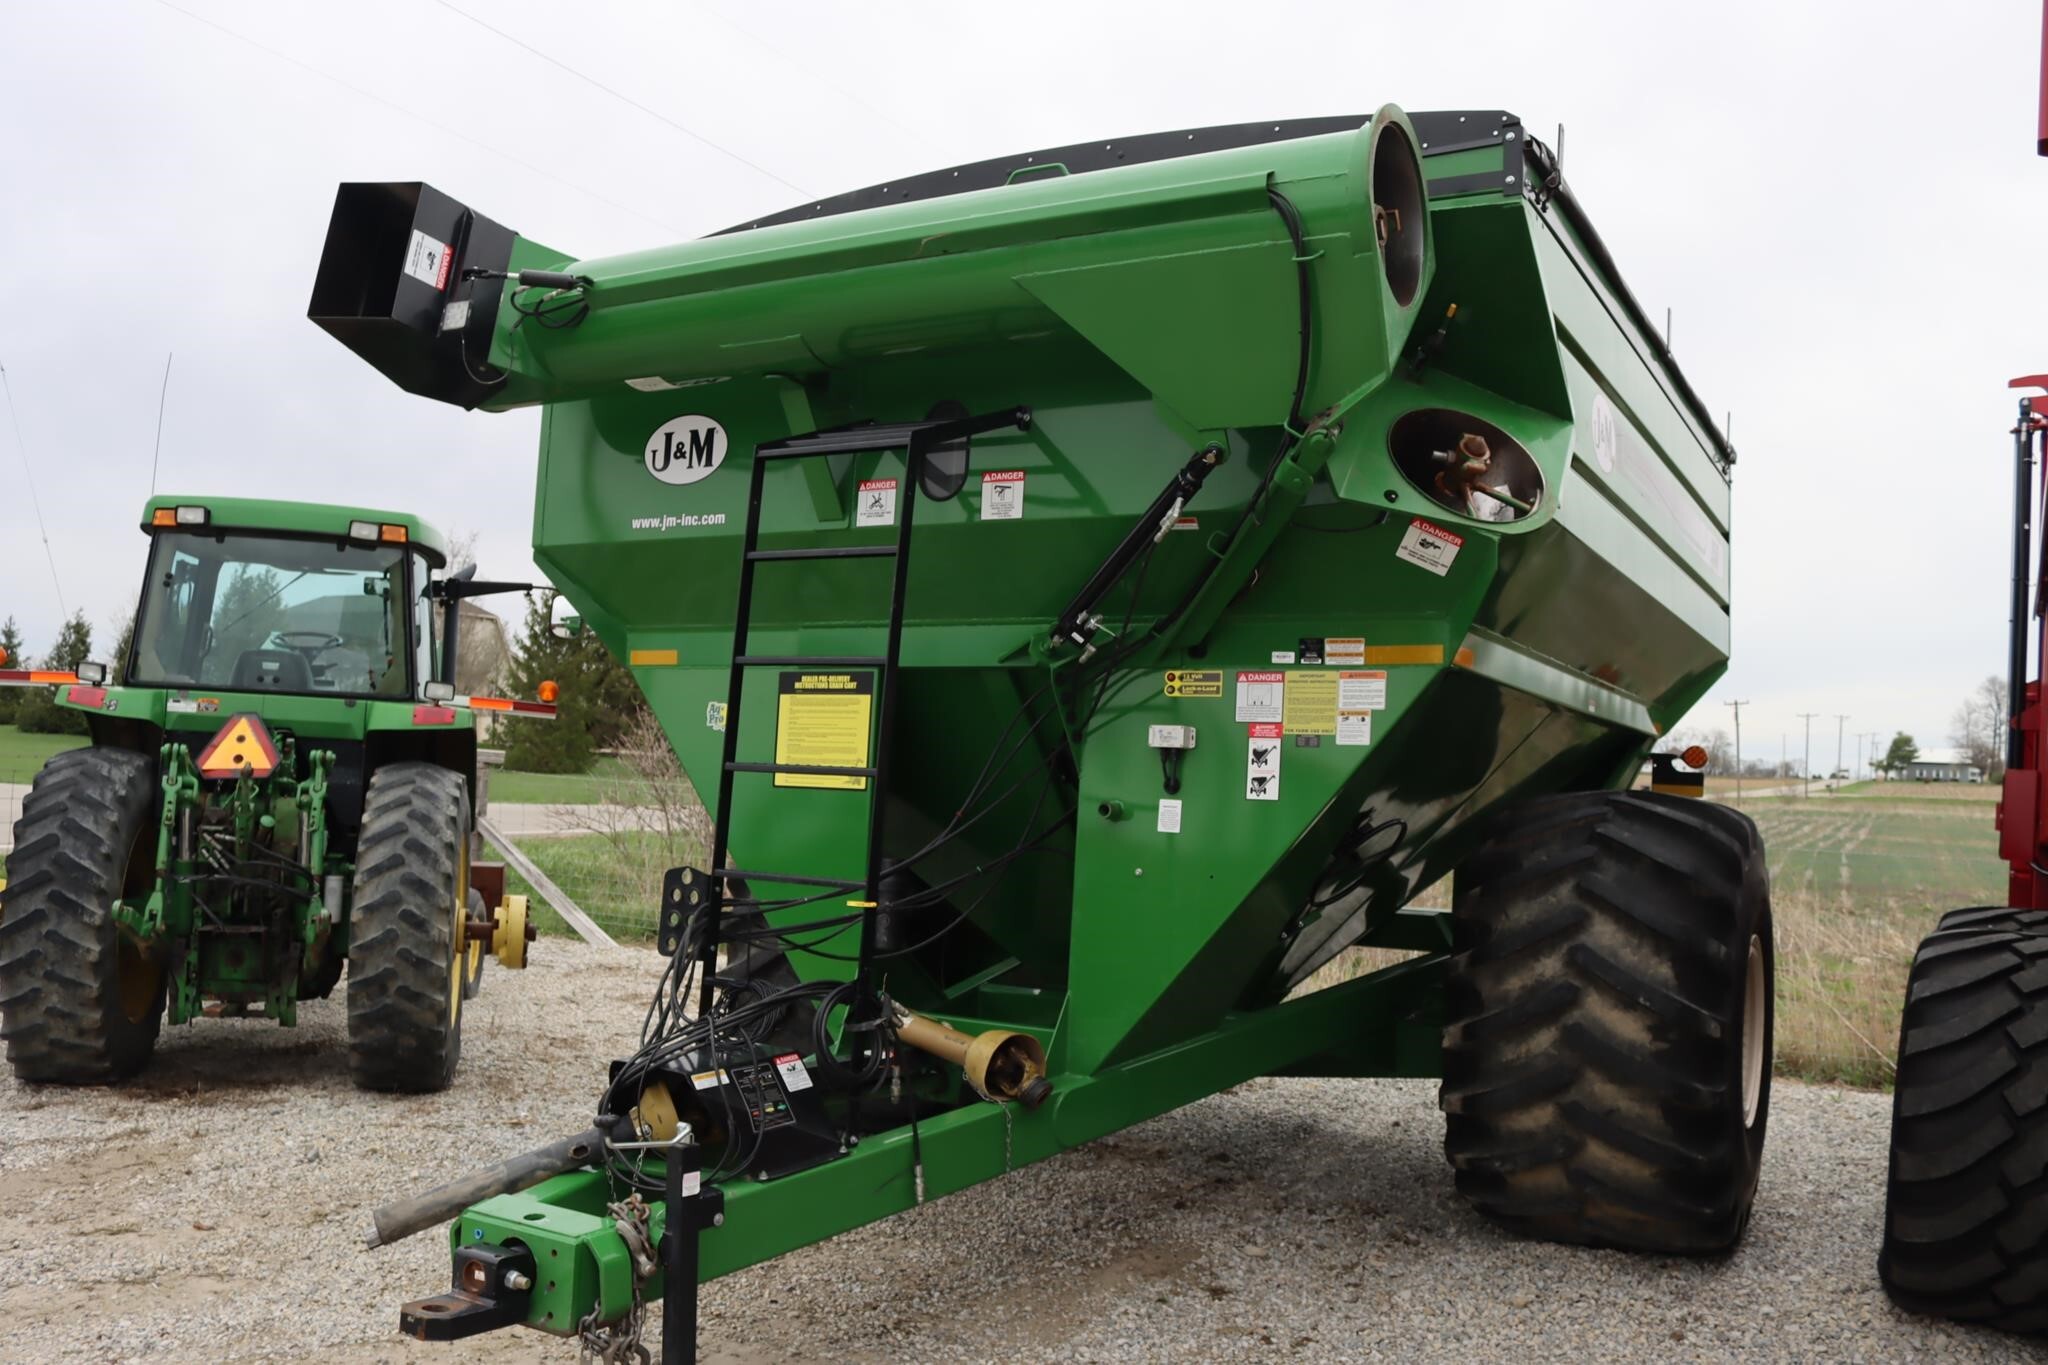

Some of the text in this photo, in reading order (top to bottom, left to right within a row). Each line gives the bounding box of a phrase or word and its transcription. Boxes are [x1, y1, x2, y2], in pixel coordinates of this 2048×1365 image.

[437, 254, 450, 289] DANGER
[651, 428, 717, 472] J&M
[991, 471, 1024, 481] DANGER
[866, 481, 896, 490] DANGER
[631, 514, 726, 532] www.jm-inc.com
[1422, 523, 1462, 546] DANGER
[1248, 673, 1283, 681] DANGER
